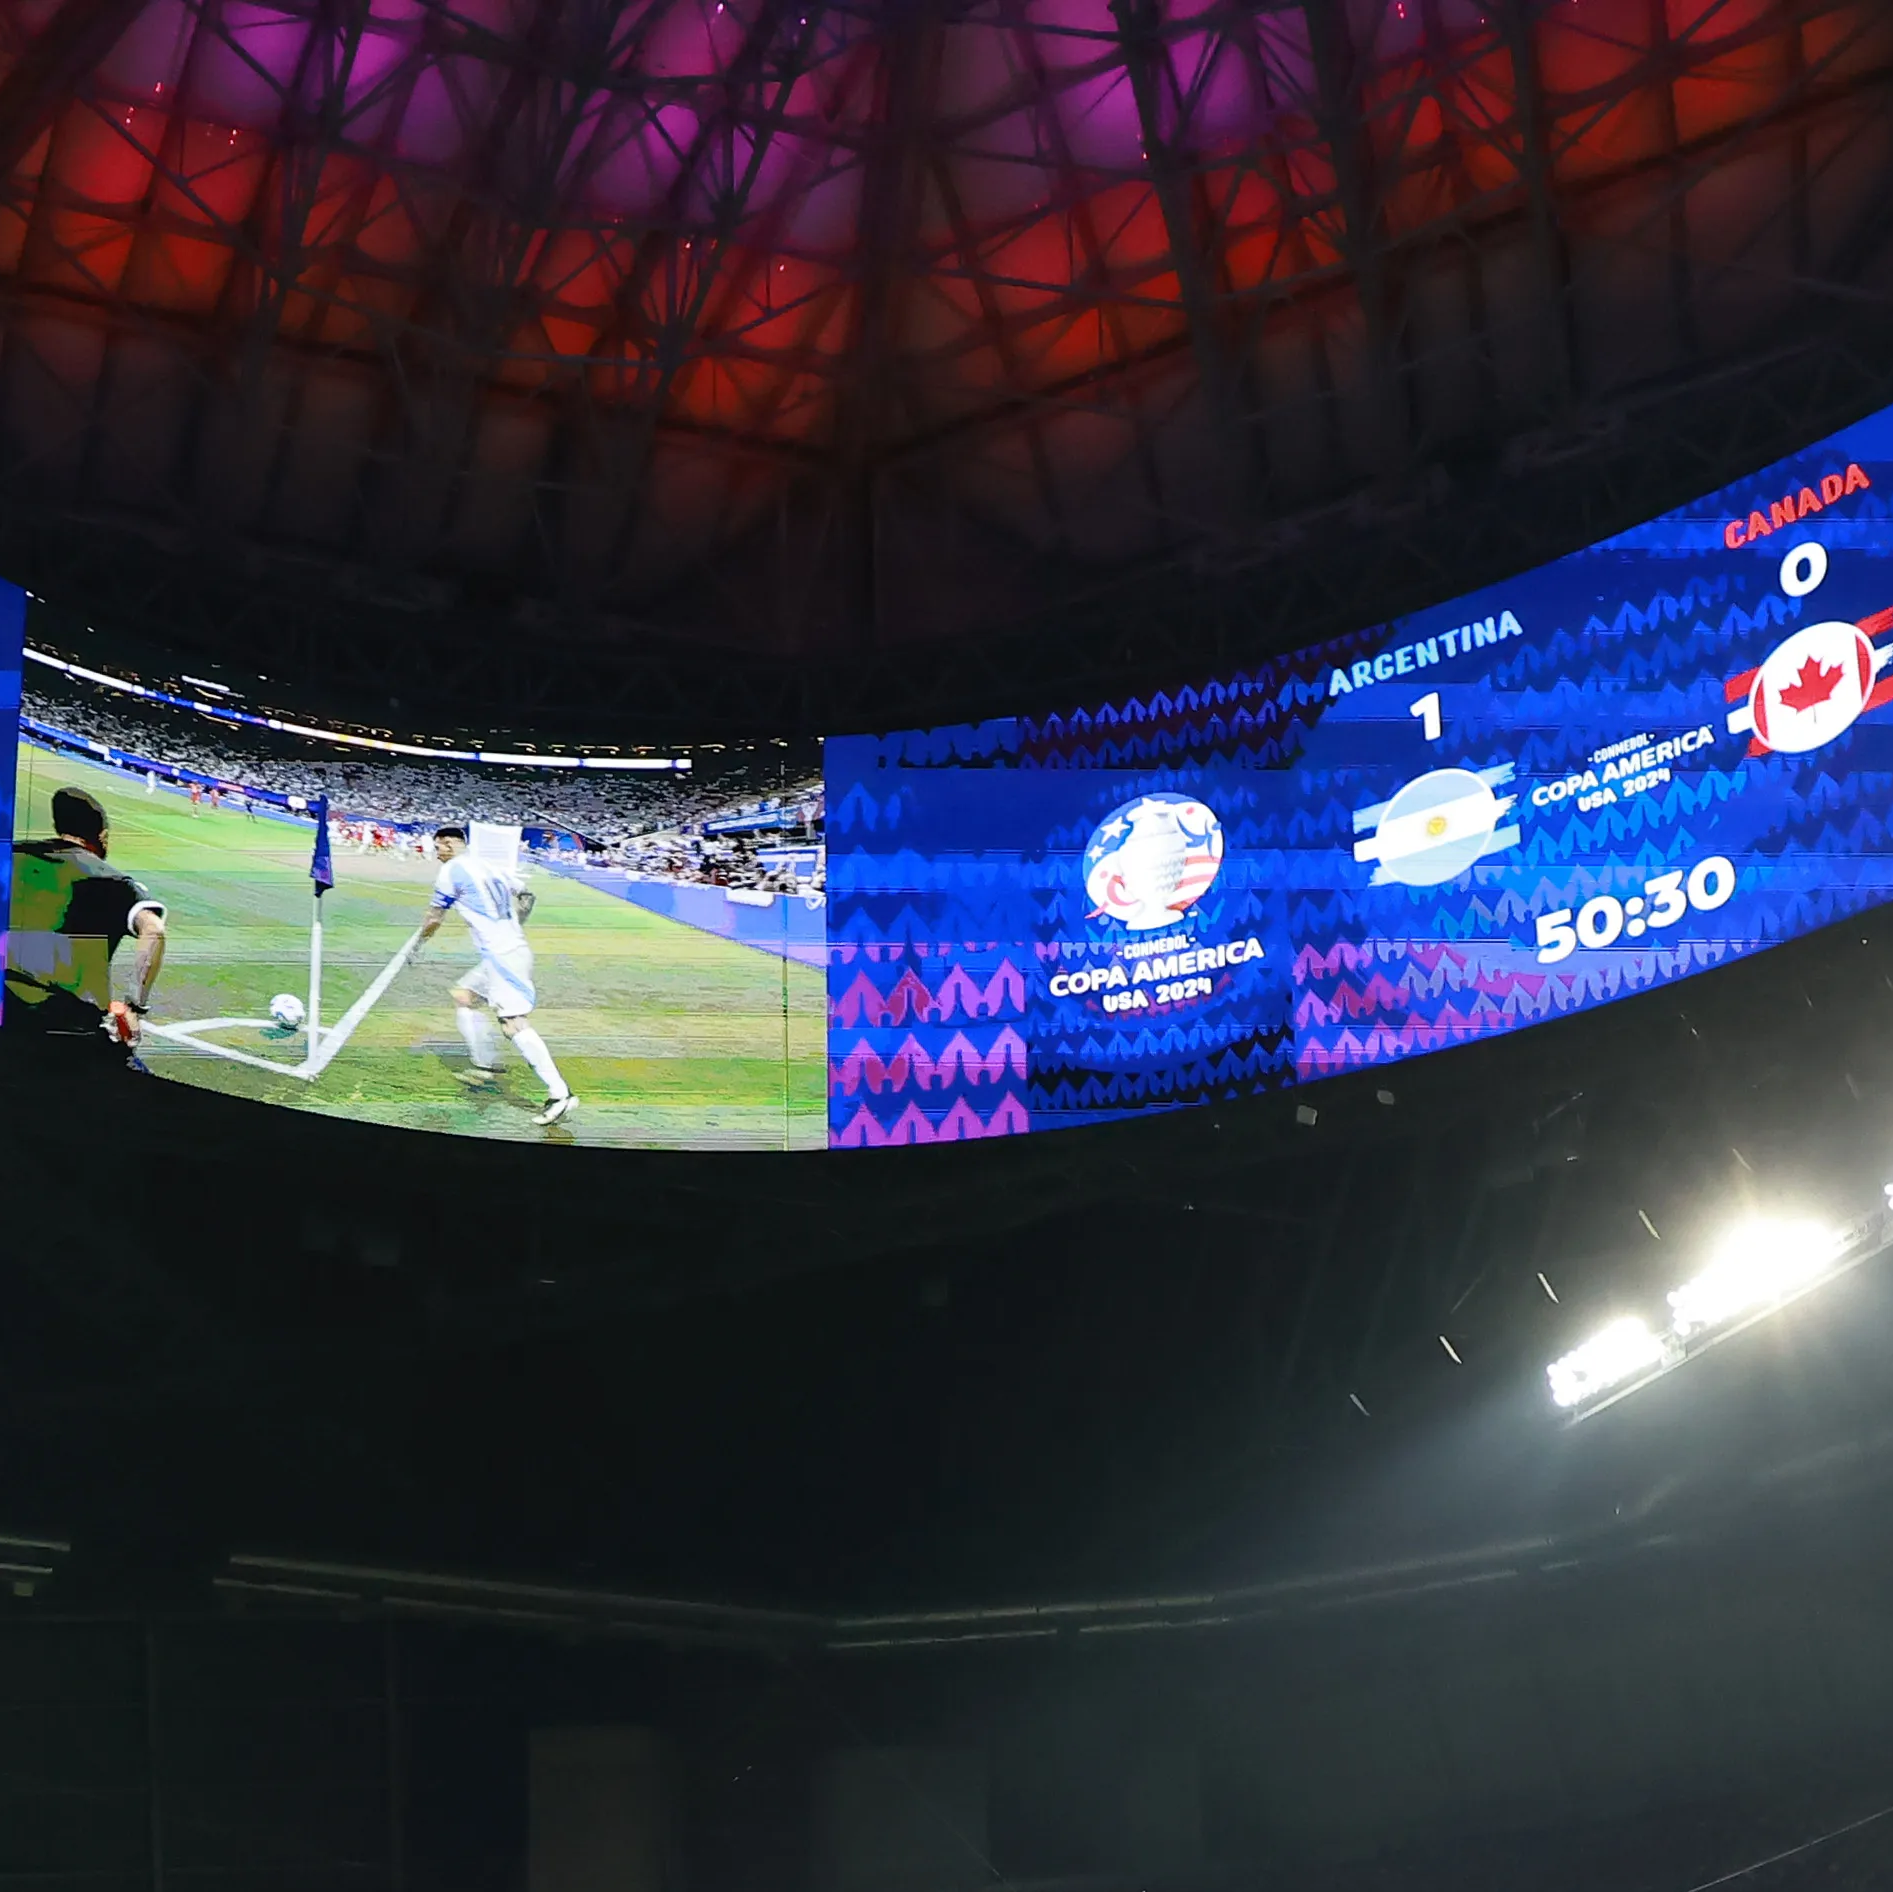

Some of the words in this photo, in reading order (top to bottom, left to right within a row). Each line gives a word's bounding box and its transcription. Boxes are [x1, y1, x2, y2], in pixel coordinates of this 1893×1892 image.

[1723, 461, 1873, 553] CANADA
[1778, 541, 1829, 598] 0
[1325, 610, 1526, 699] ARGENTINA
[1408, 690, 1445, 742] 1
[1532, 769, 1599, 806] COPA
[1602, 725, 1715, 784] AMERICA
[1577, 787, 1618, 812] USA
[1622, 767, 1671, 797] 2024
[1533, 853, 1737, 967] 50:30
[1049, 965, 1128, 998] COPA
[1132, 937, 1265, 984] AMERICA
[1102, 988, 1149, 1013] USA
[1155, 976, 1213, 1004] 2024
